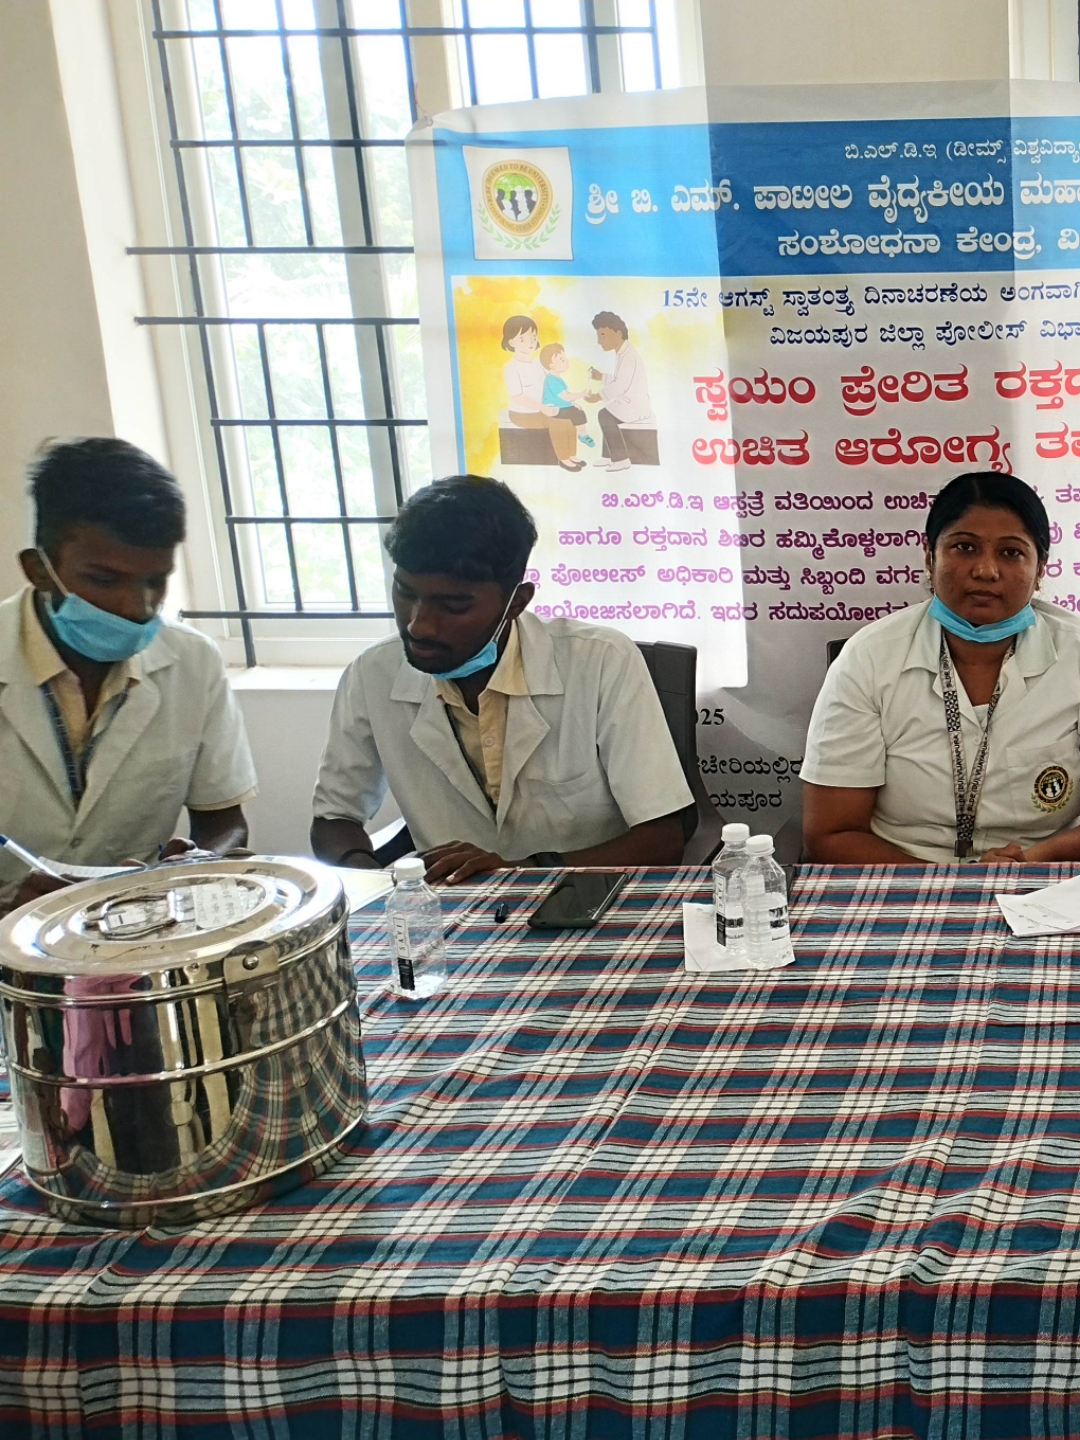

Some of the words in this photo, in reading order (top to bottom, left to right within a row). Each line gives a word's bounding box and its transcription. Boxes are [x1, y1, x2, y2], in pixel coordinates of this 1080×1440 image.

[585, 182, 619, 225] ಶ್ರೀ
[631, 187, 658, 213] ಬಿ.
[670, 178, 740, 212] ಎಮ್.
[753, 183, 853, 210] ಪಾಟೀಲ
[868, 172, 1005, 224] ವೈದ್ಯಕೀಯ
[778, 228, 941, 258] ಸಂಶೋಧನಾ
[956, 224, 1042, 260] ಕೇಂದ್ರ,
[661, 286, 708, 308] 15ನೇ
[718, 287, 775, 316] ಆಗಸ್ಟ್
[864, 282, 988, 306] ದಿನಾಚರಣೆಯ
[769, 323, 868, 348] ವಿಜಯಪುರ
[879, 322, 926, 351] ಜಿಲ್ಲಾ
[692, 366, 816, 422] ಸ್ವಯಂ
[840, 363, 969, 417] ಪ್ರೇರಿತ
[692, 428, 811, 466] ಉಚಿತ
[834, 424, 1013, 475] ಆರೋಗ್ಯ
[713, 490, 765, 519] ಆಸ್ಪತ್ರೆ
[774, 490, 874, 511] ವತಿಯಿಂದ
[558, 526, 623, 546] ಹಾಗೂ
[632, 526, 708, 552] ರಕ್ತದಾನ
[717, 528, 766, 548] ಶಿಬಿರ
[657, 565, 734, 586] ಅಧಿಕಾರಿ
[743, 564, 791, 591] ಮತ್ತು
[800, 566, 866, 595] ಸಿಬ್ಬಂದಿ
[875, 564, 924, 585] ವರ್ಗ
[710, 601, 758, 622] ಇದರ
[696, 707, 725, 726] 25
[953, 734, 963, 776] VIJAYAPURA
